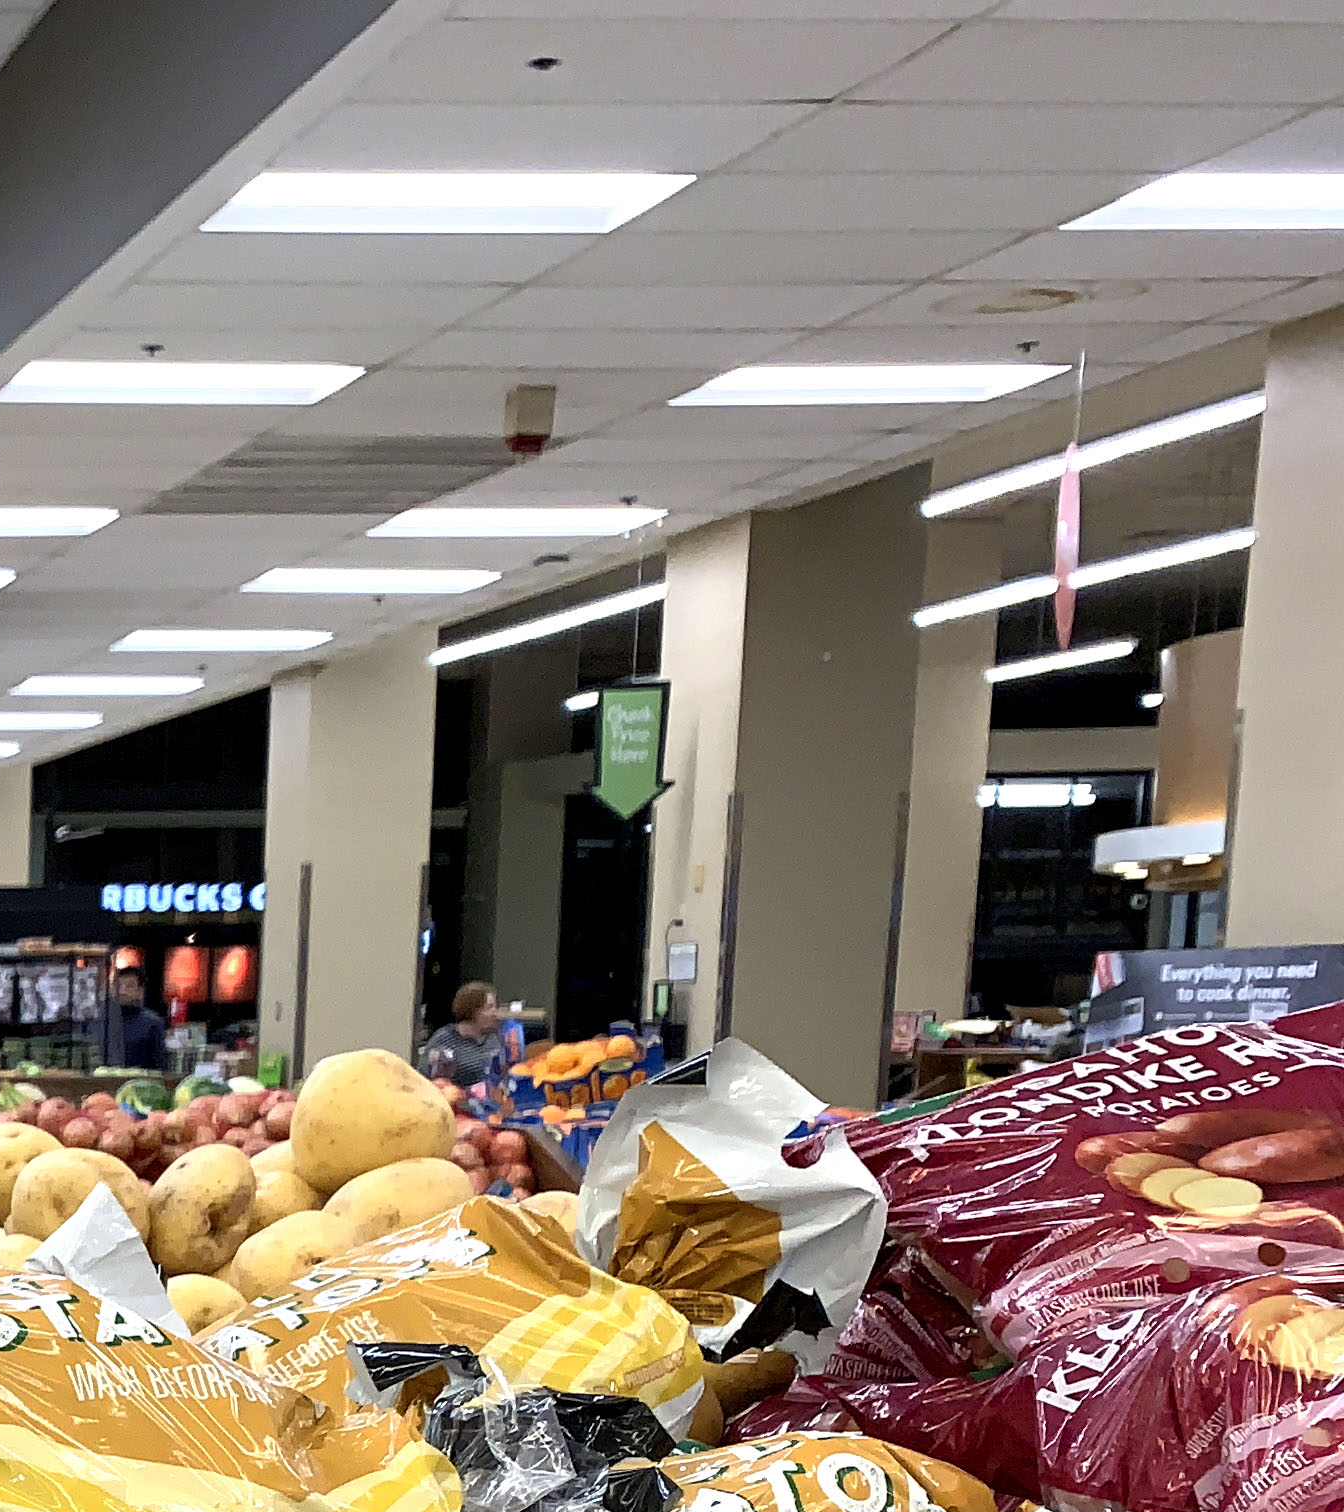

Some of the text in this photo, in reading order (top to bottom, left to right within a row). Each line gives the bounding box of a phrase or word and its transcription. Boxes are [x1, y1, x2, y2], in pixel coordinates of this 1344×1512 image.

[1162, 960, 1318, 985] Everything you need
[1176, 988, 1194, 1003] to
[1133, 1273, 1163, 1299] USE
[65, 1361, 141, 1402] WASH
[1273, 1447, 1313, 1477] USE
